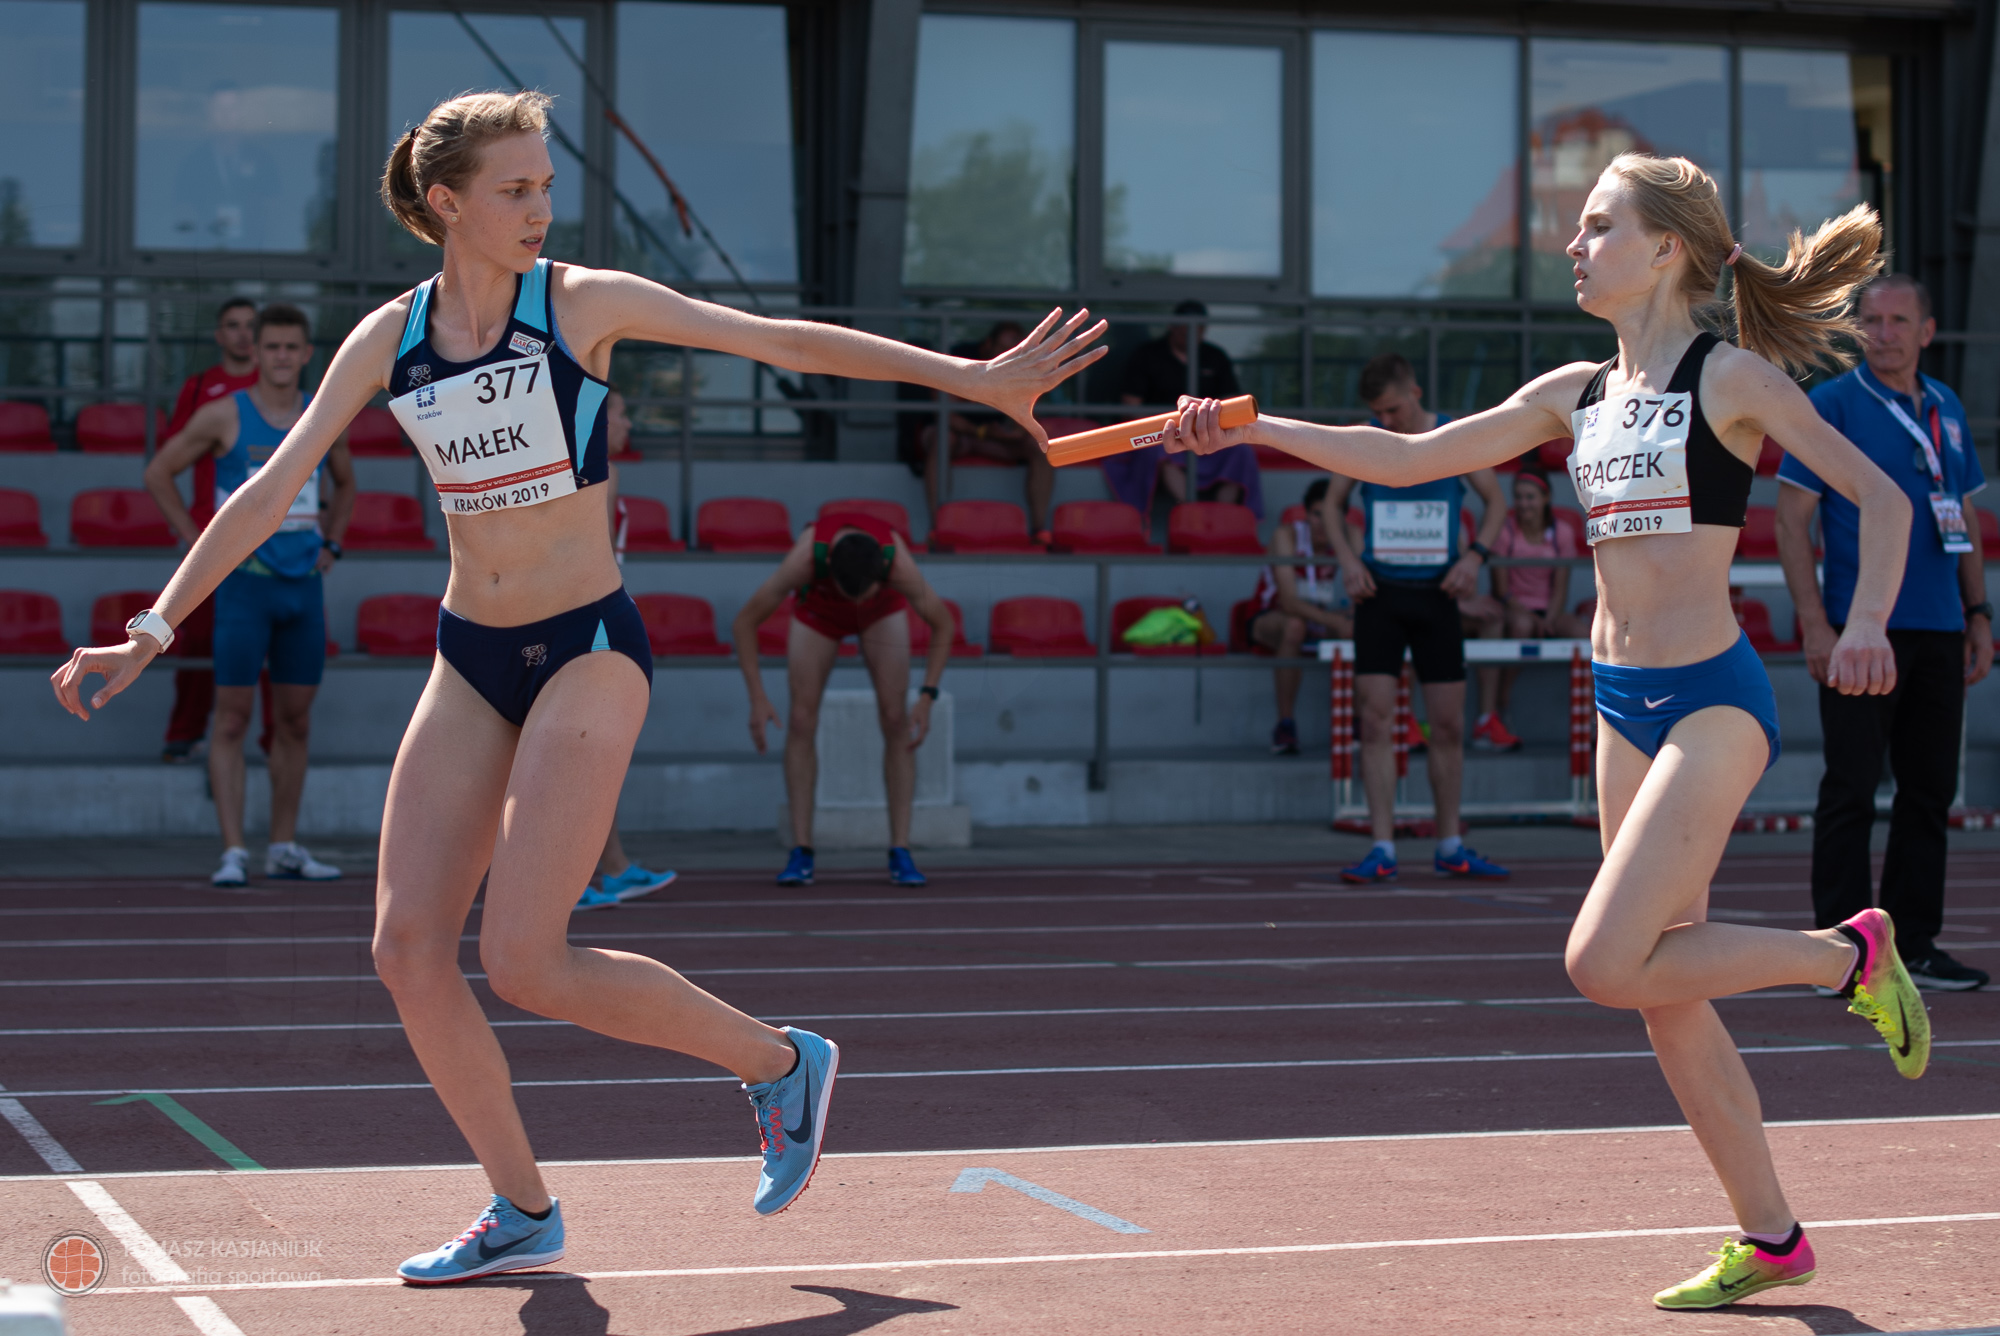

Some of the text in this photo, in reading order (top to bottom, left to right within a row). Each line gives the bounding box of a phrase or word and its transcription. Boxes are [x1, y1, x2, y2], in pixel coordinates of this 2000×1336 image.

[474, 362, 540, 405] 377
[416, 410, 443, 421] Kraków
[1622, 398, 1685, 430] 376
[434, 423, 531, 467] MAŁEK
[1575, 451, 1665, 490] FRĄCZEK
[453, 482, 549, 512] KRAKÓW 2019
[1414, 503, 1445, 520] 379
[1623, 515, 1663, 533] 2019
